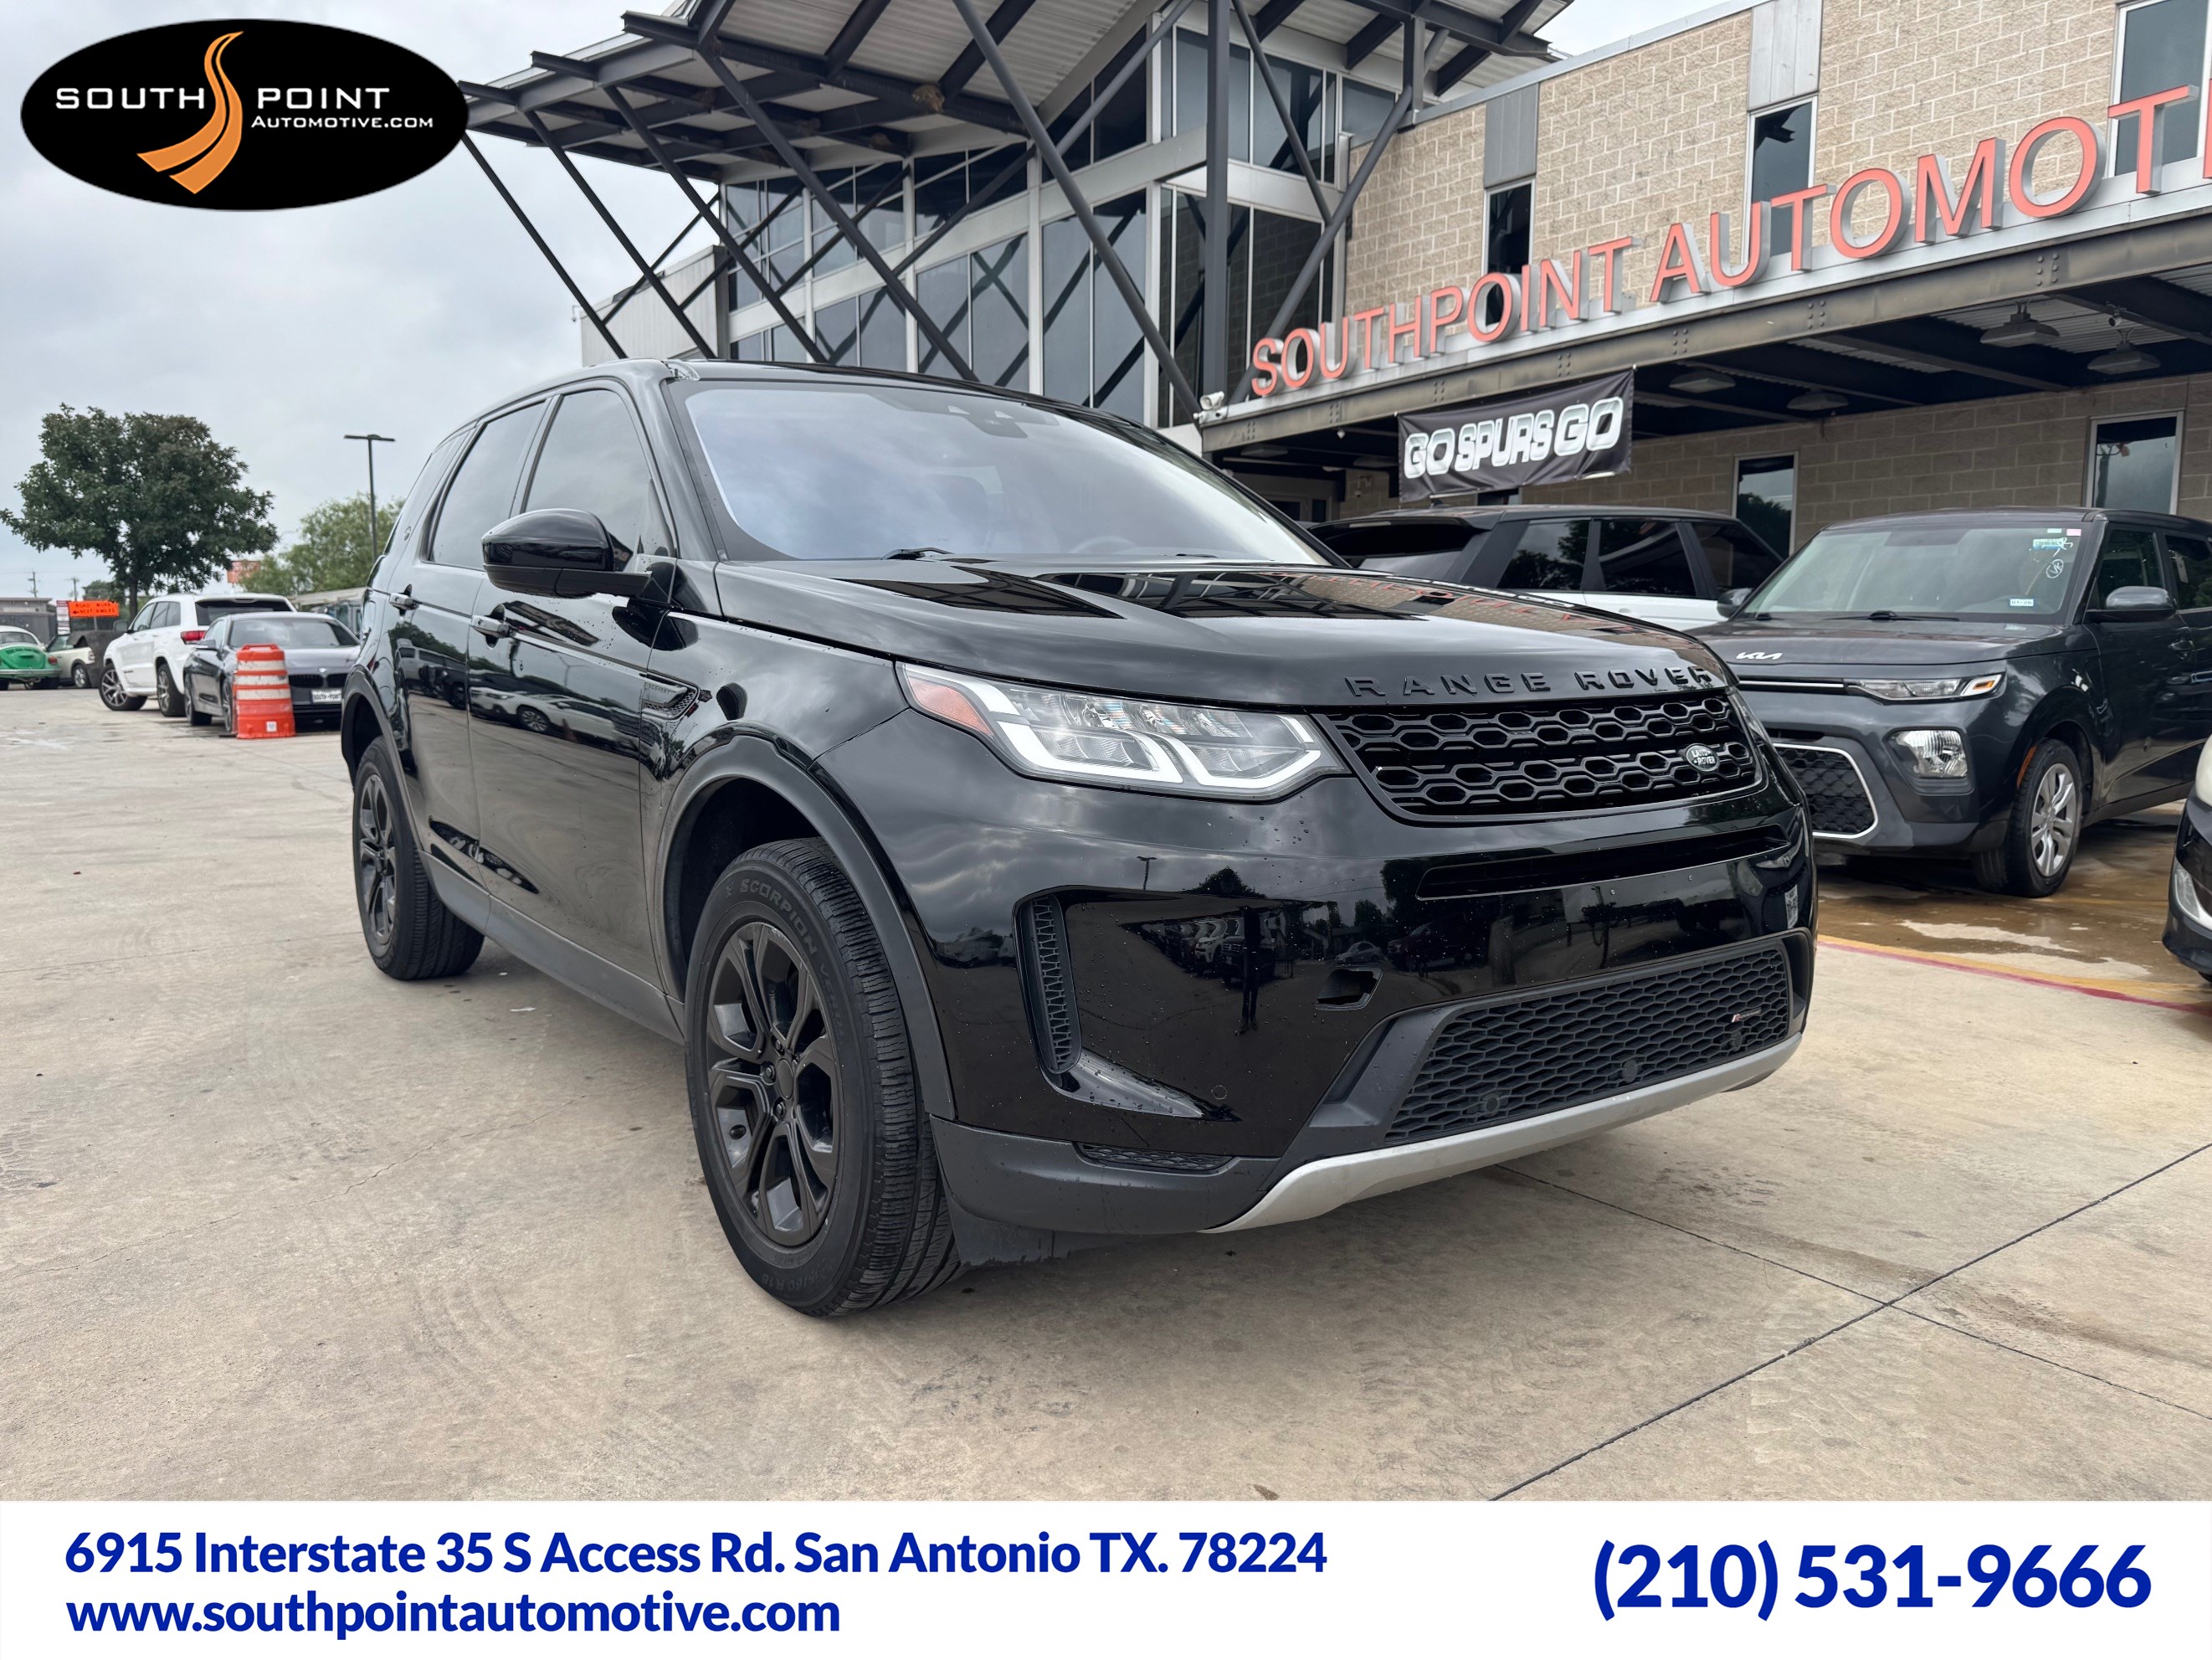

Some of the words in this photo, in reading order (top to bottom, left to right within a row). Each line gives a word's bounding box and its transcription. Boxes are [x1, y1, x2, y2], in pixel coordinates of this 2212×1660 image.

[1252, 238, 1638, 395] SOUTHPOINT
[1404, 427, 1455, 479] GO
[1454, 409, 1555, 472] SPURS
[1553, 396, 1624, 457] GO
[1735, 651, 1783, 660] KIA
[1344, 671, 1551, 697] RANGE
[1577, 665, 1714, 691] ROVER
[1691, 748, 1708, 758] LAND
[1696, 756, 1717, 765] ROVER
[739, 878, 818, 955] SCORPION
